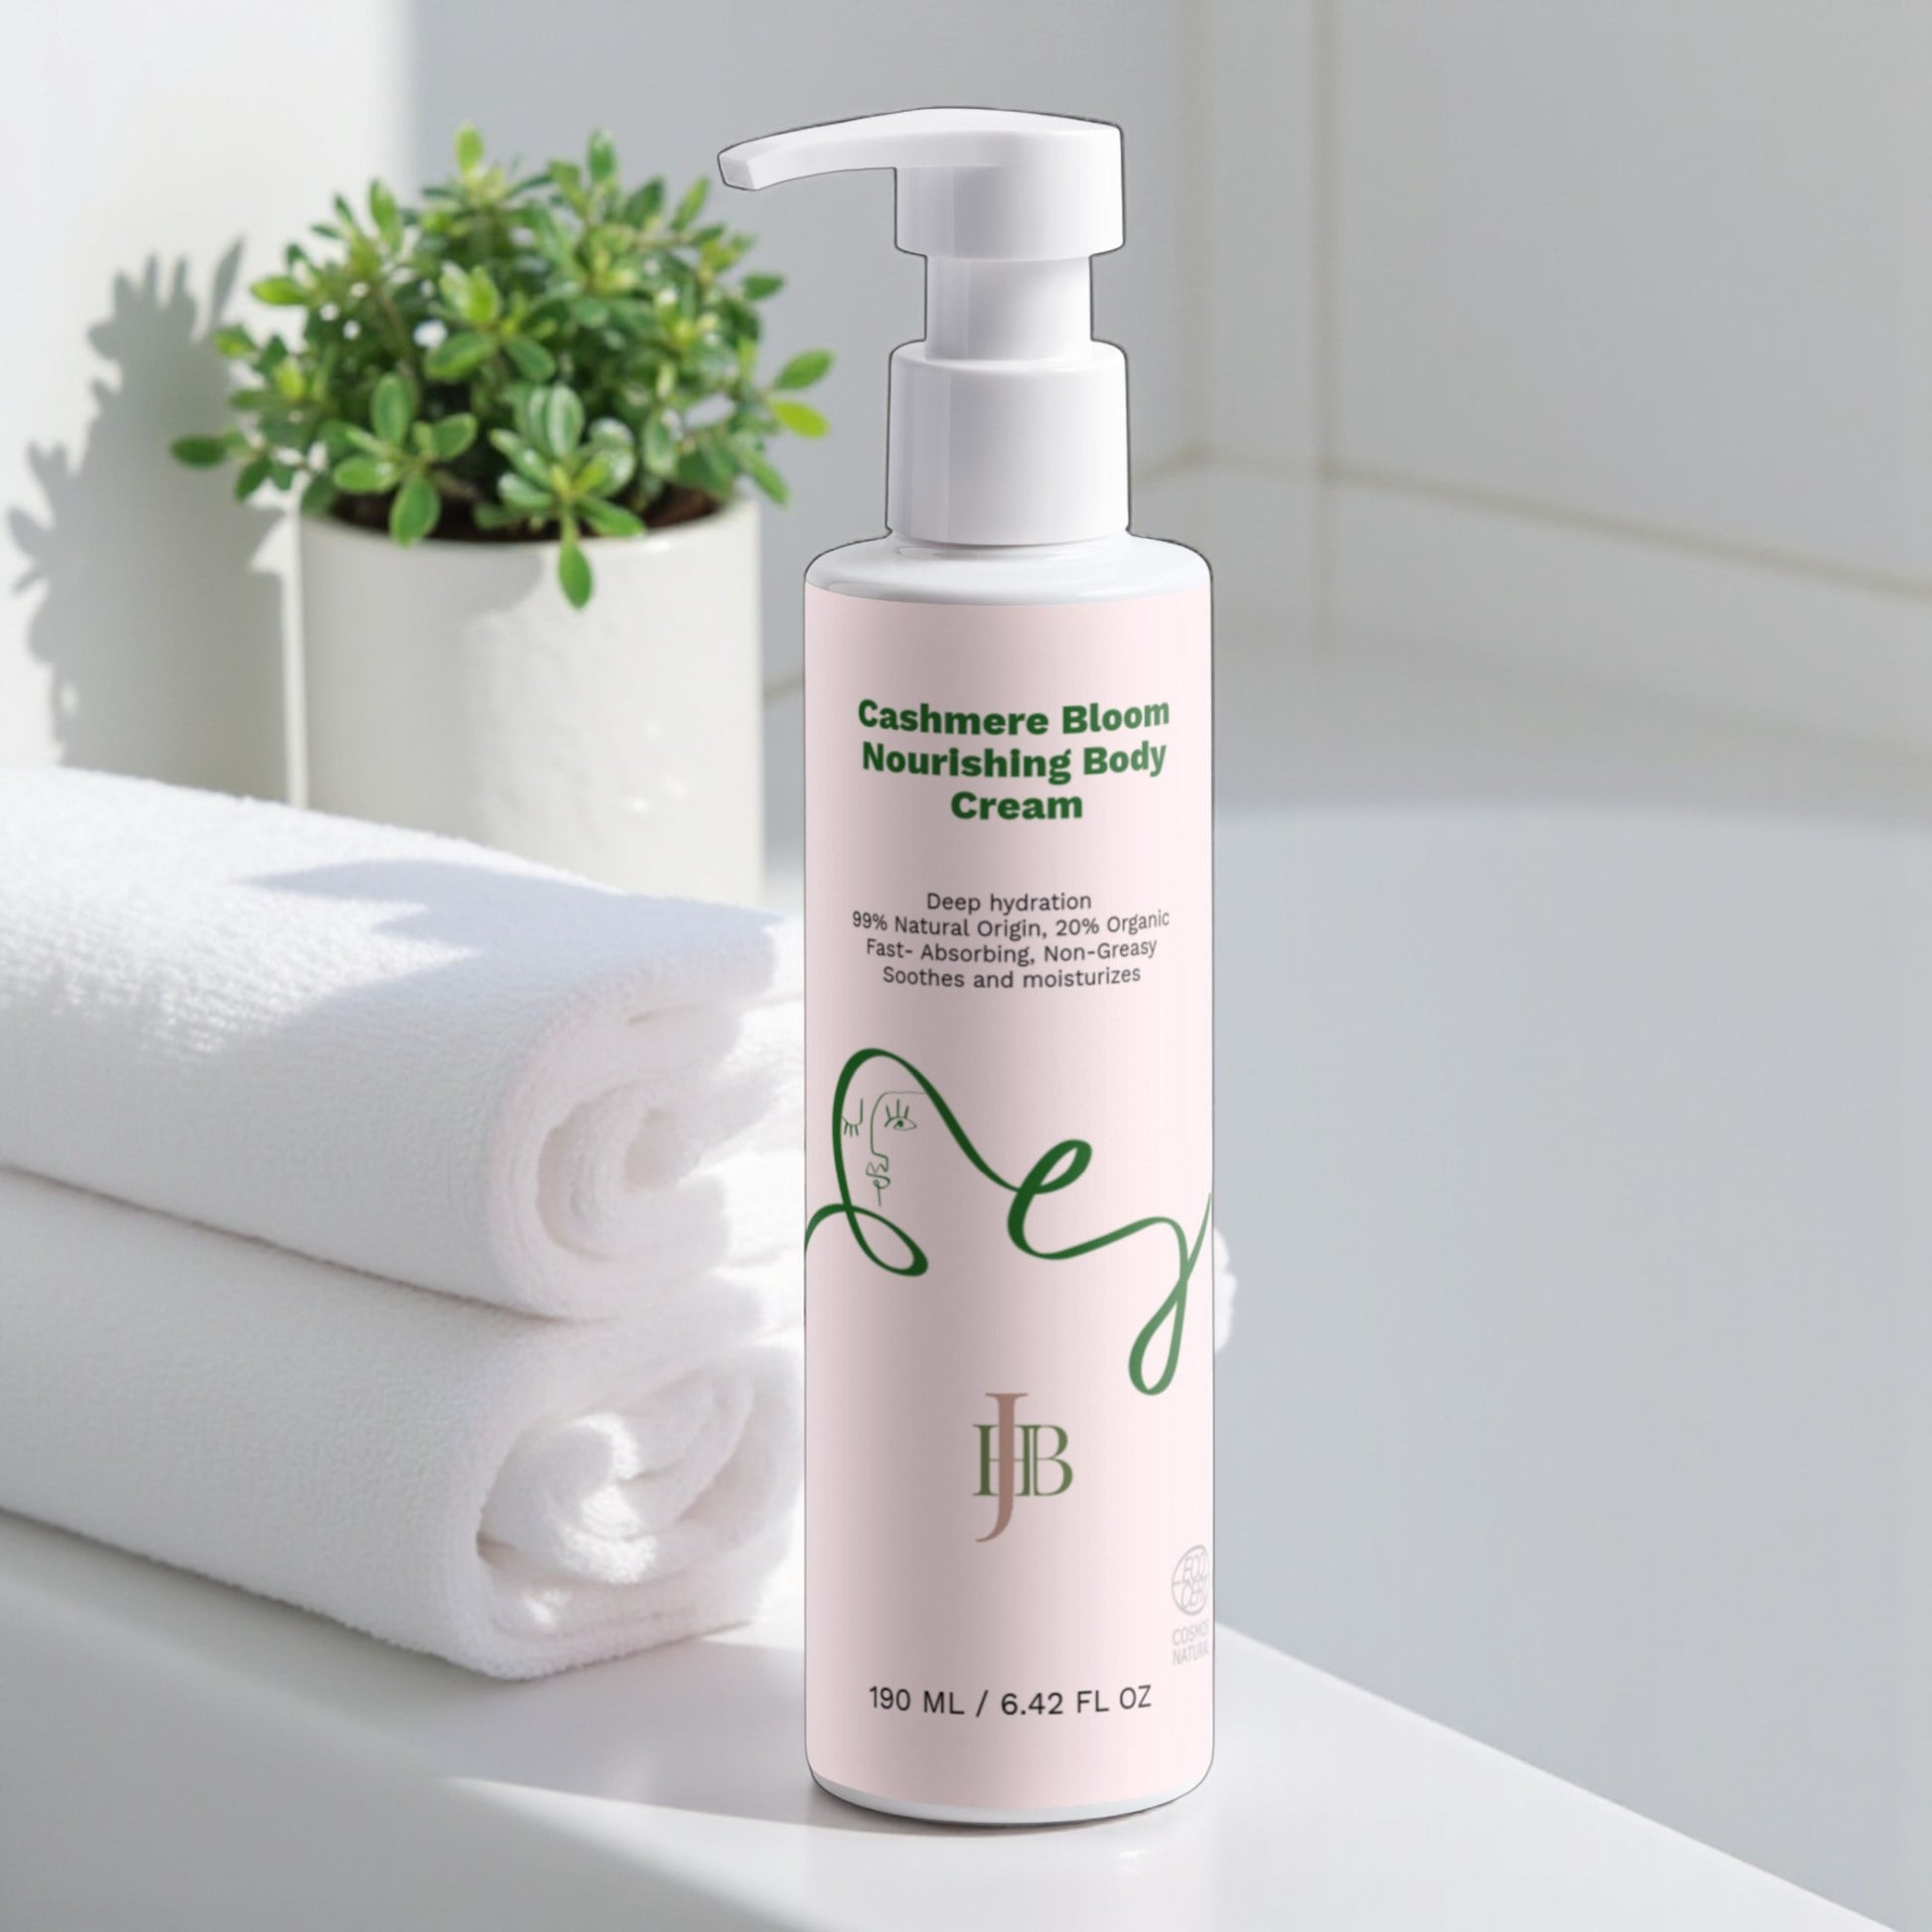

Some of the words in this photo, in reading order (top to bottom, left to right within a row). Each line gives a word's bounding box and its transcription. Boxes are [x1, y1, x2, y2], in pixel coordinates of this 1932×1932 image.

[857, 698, 1050, 737] Cashmere
[1061, 701, 1171, 736] Bloom
[862, 740, 1073, 787] Nourishing
[1082, 739, 1169, 778] Body
[949, 789, 1084, 822] Cream
[926, 892, 982, 916] Deep
[989, 891, 1092, 917] hydration
[852, 909, 889, 932] 99%
[894, 914, 971, 938] Natural
[976, 917, 1048, 943] Origin,
[1054, 916, 1101, 938] 20%
[1106, 908, 1171, 936] Organic
[866, 937, 914, 959] Fast-
[919, 942, 1036, 968] Absorbing,
[1043, 938, 1159, 963] Non-Greasy
[882, 965, 966, 989] Soothes
[972, 969, 1015, 990] and
[1022, 965, 1142, 989] moisturizes
[869, 1685, 912, 1713] 190
[922, 1689, 966, 1716] ML
[974, 1689, 990, 1719] /
[1000, 1691, 1064, 1717] 6.42
[1075, 1689, 1111, 1715] FL
[1118, 1683, 1153, 1711] OZ
